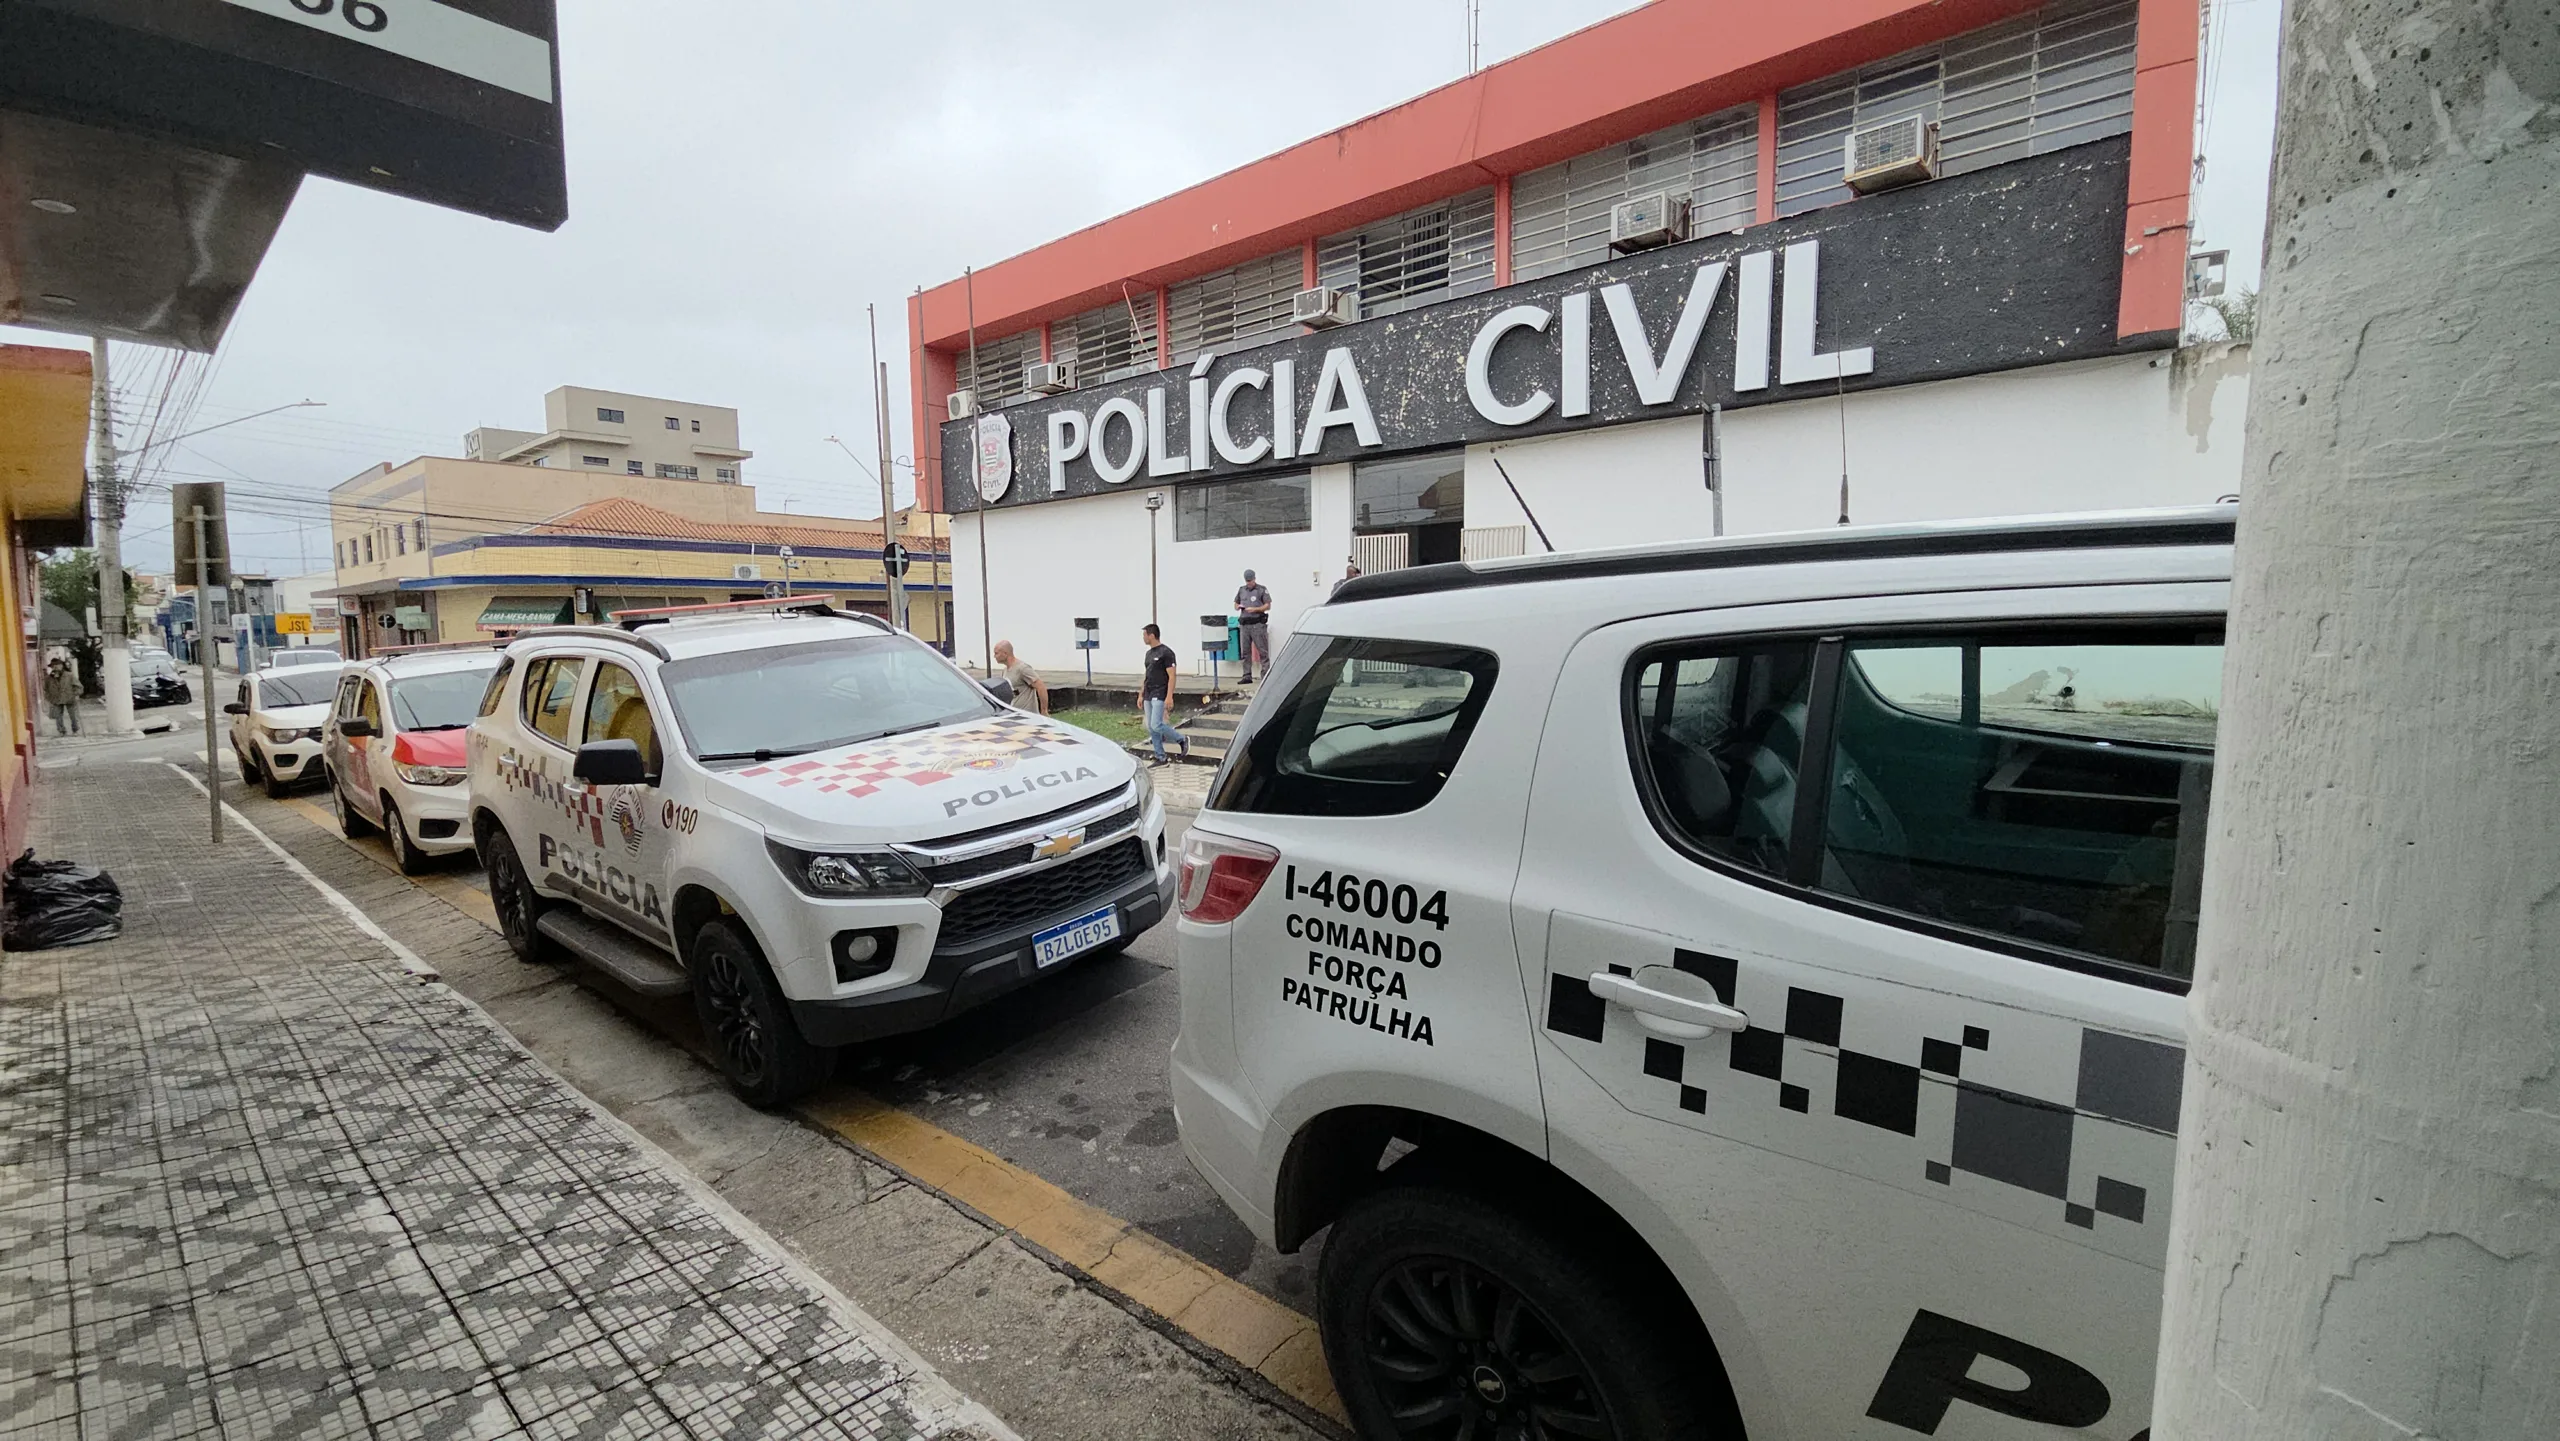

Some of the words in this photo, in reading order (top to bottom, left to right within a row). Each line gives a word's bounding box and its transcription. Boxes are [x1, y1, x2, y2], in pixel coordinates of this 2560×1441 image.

[1048, 346, 1383, 493] POLÍCIA
[1465, 239, 1875, 427] CIVIL
[982, 479, 1001, 490] CIVIL
[288, 620, 307, 632] JSL
[675, 804, 699, 835] 190
[942, 766, 1099, 819] POLÍCIA
[539, 832, 668, 929] POLÍCIA
[1285, 864, 1450, 932] I-46004
[1286, 913, 1442, 969] COMANDO
[1308, 950, 1408, 1000] FORÇA
[1282, 977, 1435, 1047] PATRULHA
[1865, 1308, 2150, 1441] P
